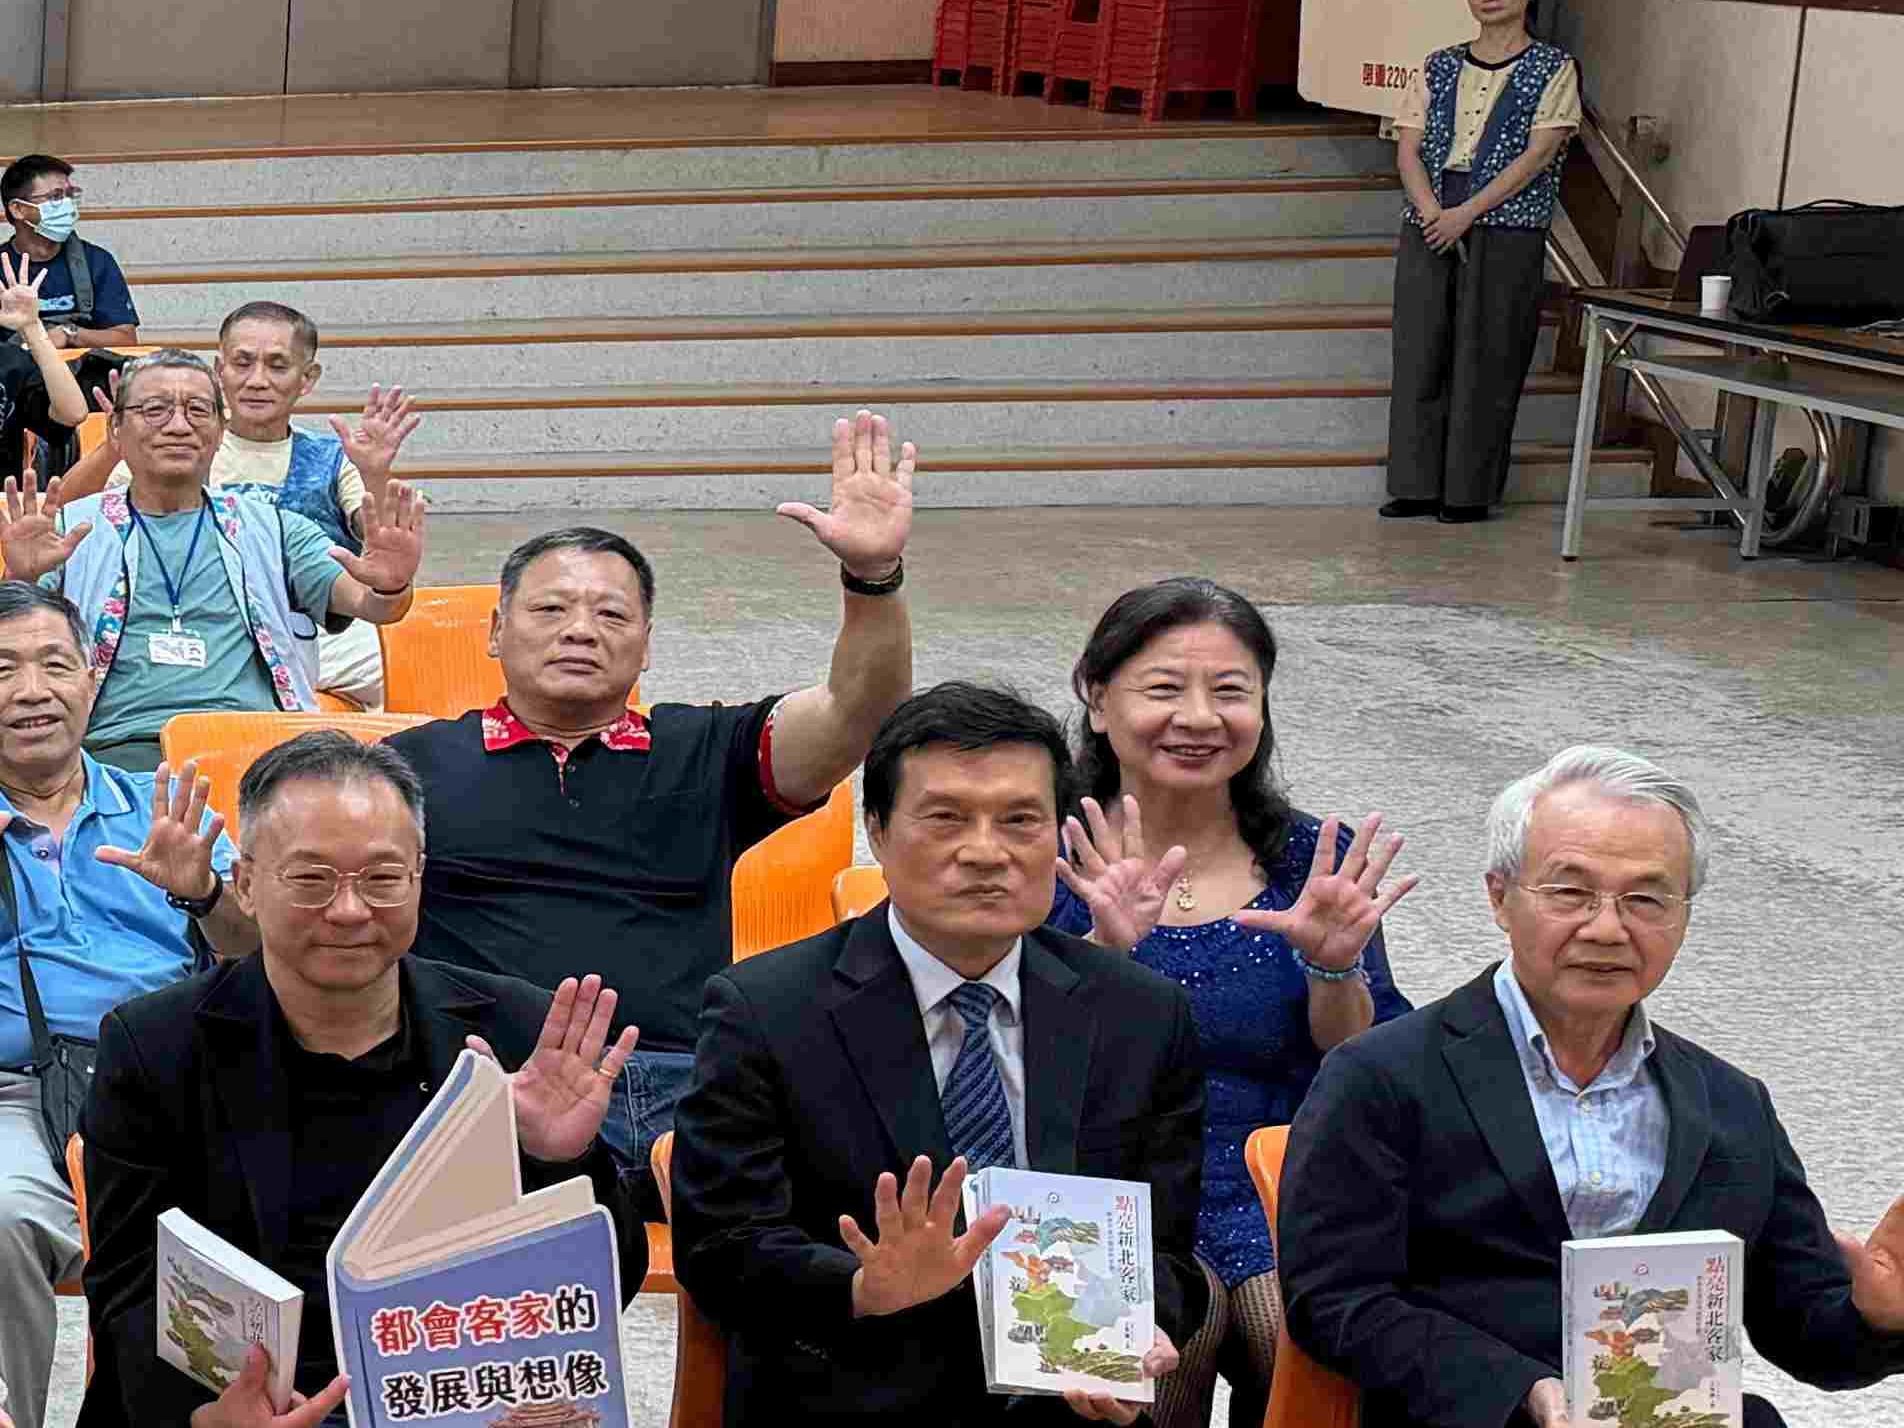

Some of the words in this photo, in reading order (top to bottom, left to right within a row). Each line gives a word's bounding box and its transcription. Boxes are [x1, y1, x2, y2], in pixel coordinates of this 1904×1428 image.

[373, 1287, 598, 1354] 都會客家的
[383, 1354, 608, 1420] 發展與想像
